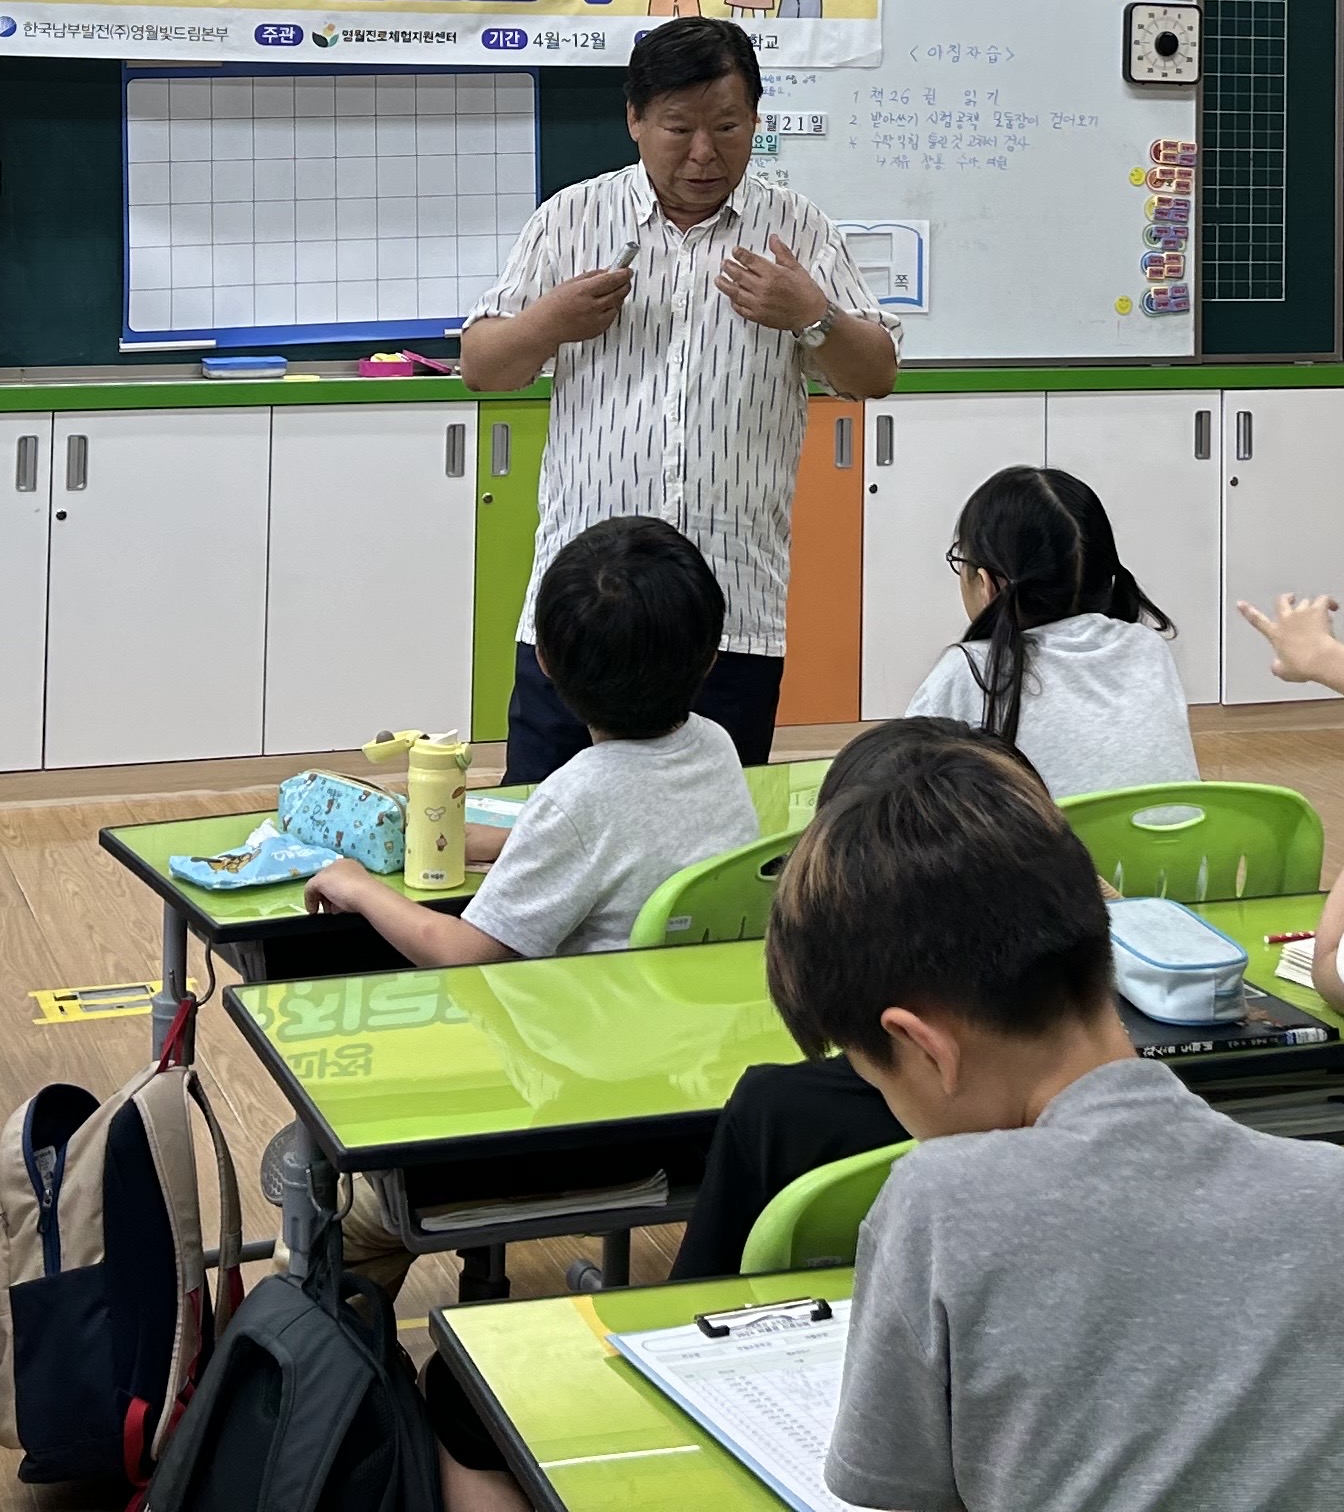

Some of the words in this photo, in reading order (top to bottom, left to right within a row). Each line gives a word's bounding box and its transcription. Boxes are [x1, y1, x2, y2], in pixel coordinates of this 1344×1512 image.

[22, 20, 230, 44] 한국남부발전(주)영월빛드림본부
[260, 24, 297, 45] 주관
[342, 28, 458, 45] 영월진로체험지원센터
[488, 29, 521, 49] 기간
[532, 31, 607, 51] 4월~12월
[765, 114, 777, 132] 월
[811, 115, 823, 133] 일
[870, 110, 919, 129] 받아쓰기
[893, 273, 910, 292] 쪽
